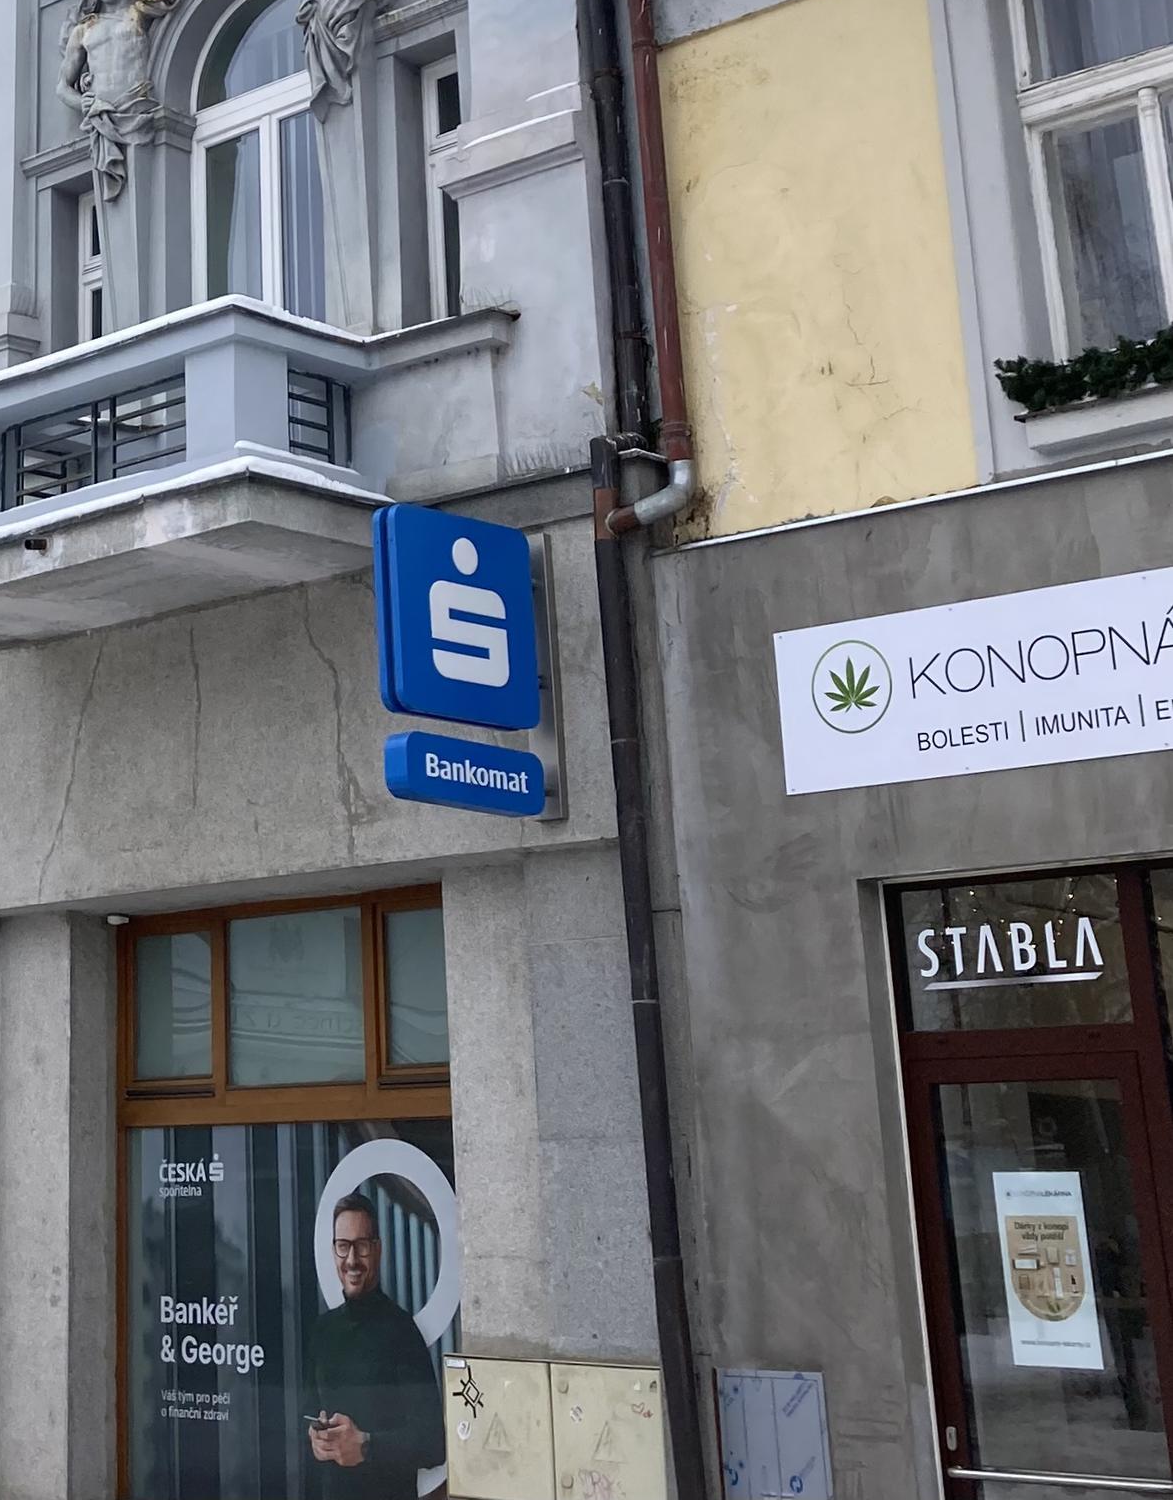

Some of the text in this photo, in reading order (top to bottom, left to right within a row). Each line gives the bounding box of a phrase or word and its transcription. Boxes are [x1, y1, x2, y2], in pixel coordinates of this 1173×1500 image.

[917, 721, 1009, 751] BOLESTI
[1035, 705, 1131, 736] IMUNITA
[425, 752, 530, 794] Bankomat
[917, 916, 1104, 978] STABLA
[159, 1158, 206, 1182] ČESKÁ
[160, 1296, 238, 1325] Bankéř
[161, 1335, 264, 1374] & George
[196, 1393, 210, 1405] pro
